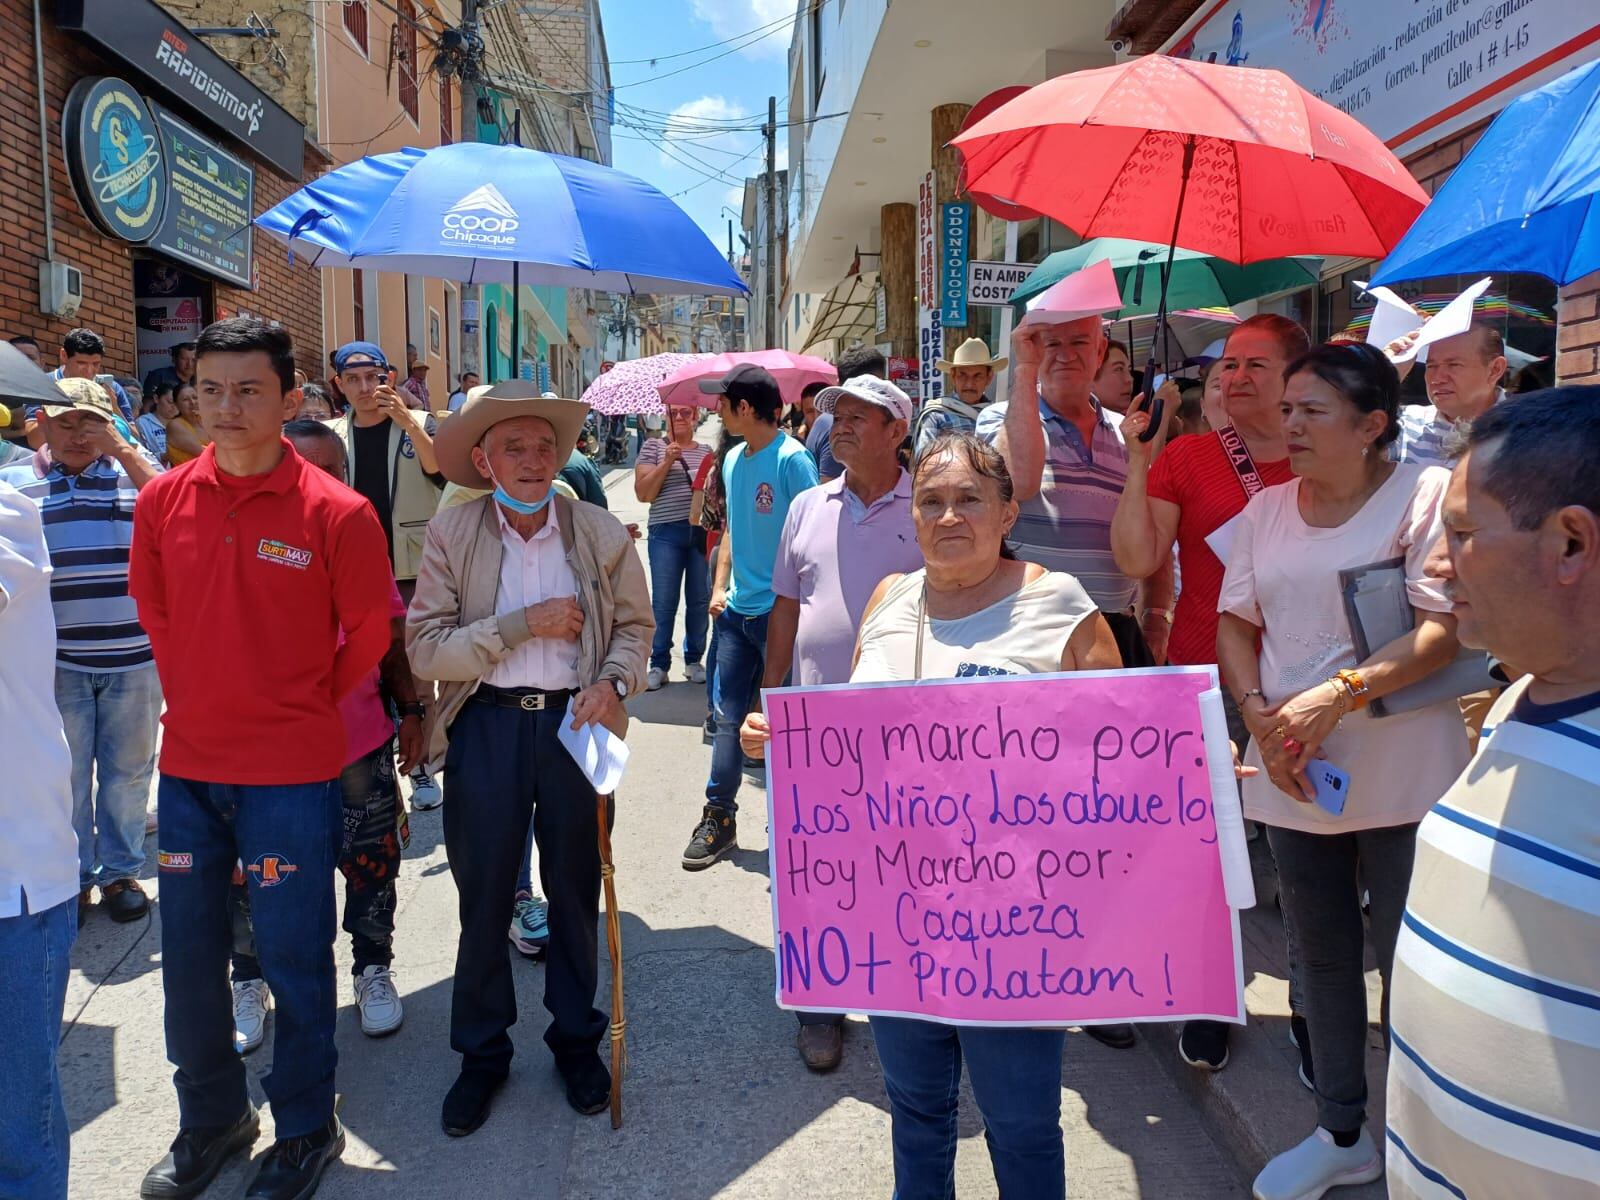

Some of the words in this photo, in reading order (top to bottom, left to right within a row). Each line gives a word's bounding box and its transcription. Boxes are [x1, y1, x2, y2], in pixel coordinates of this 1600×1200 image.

[1329, 44, 1386, 94] digitalización
[1395, 5, 1442, 51] redacción
[1385, 61, 1418, 91] Correo.
[1447, 61, 1473, 90] Calle
[441, 228, 516, 245] Chipaque
[443, 213, 519, 233] COOP
[919, 183, 927, 306] DOCTORA
[948, 206, 963, 319] ODONTOLOGIA
[974, 268, 992, 280] EN
[996, 269, 1032, 283] AMB
[1222, 430, 1248, 465] LOLA
[262, 543, 309, 562] SURTIMAX
[778, 697, 864, 796] Hoy
[881, 706, 1060, 762] marcho
[791, 784, 850, 835] Los
[989, 770, 1055, 826] Los
[787, 840, 857, 909] Hoy
[875, 840, 1017, 891] Marcho
[1036, 847, 1133, 900] por:
[896, 892, 1084, 960] Cáqueza
[909, 948, 1144, 1001] ProLatam
